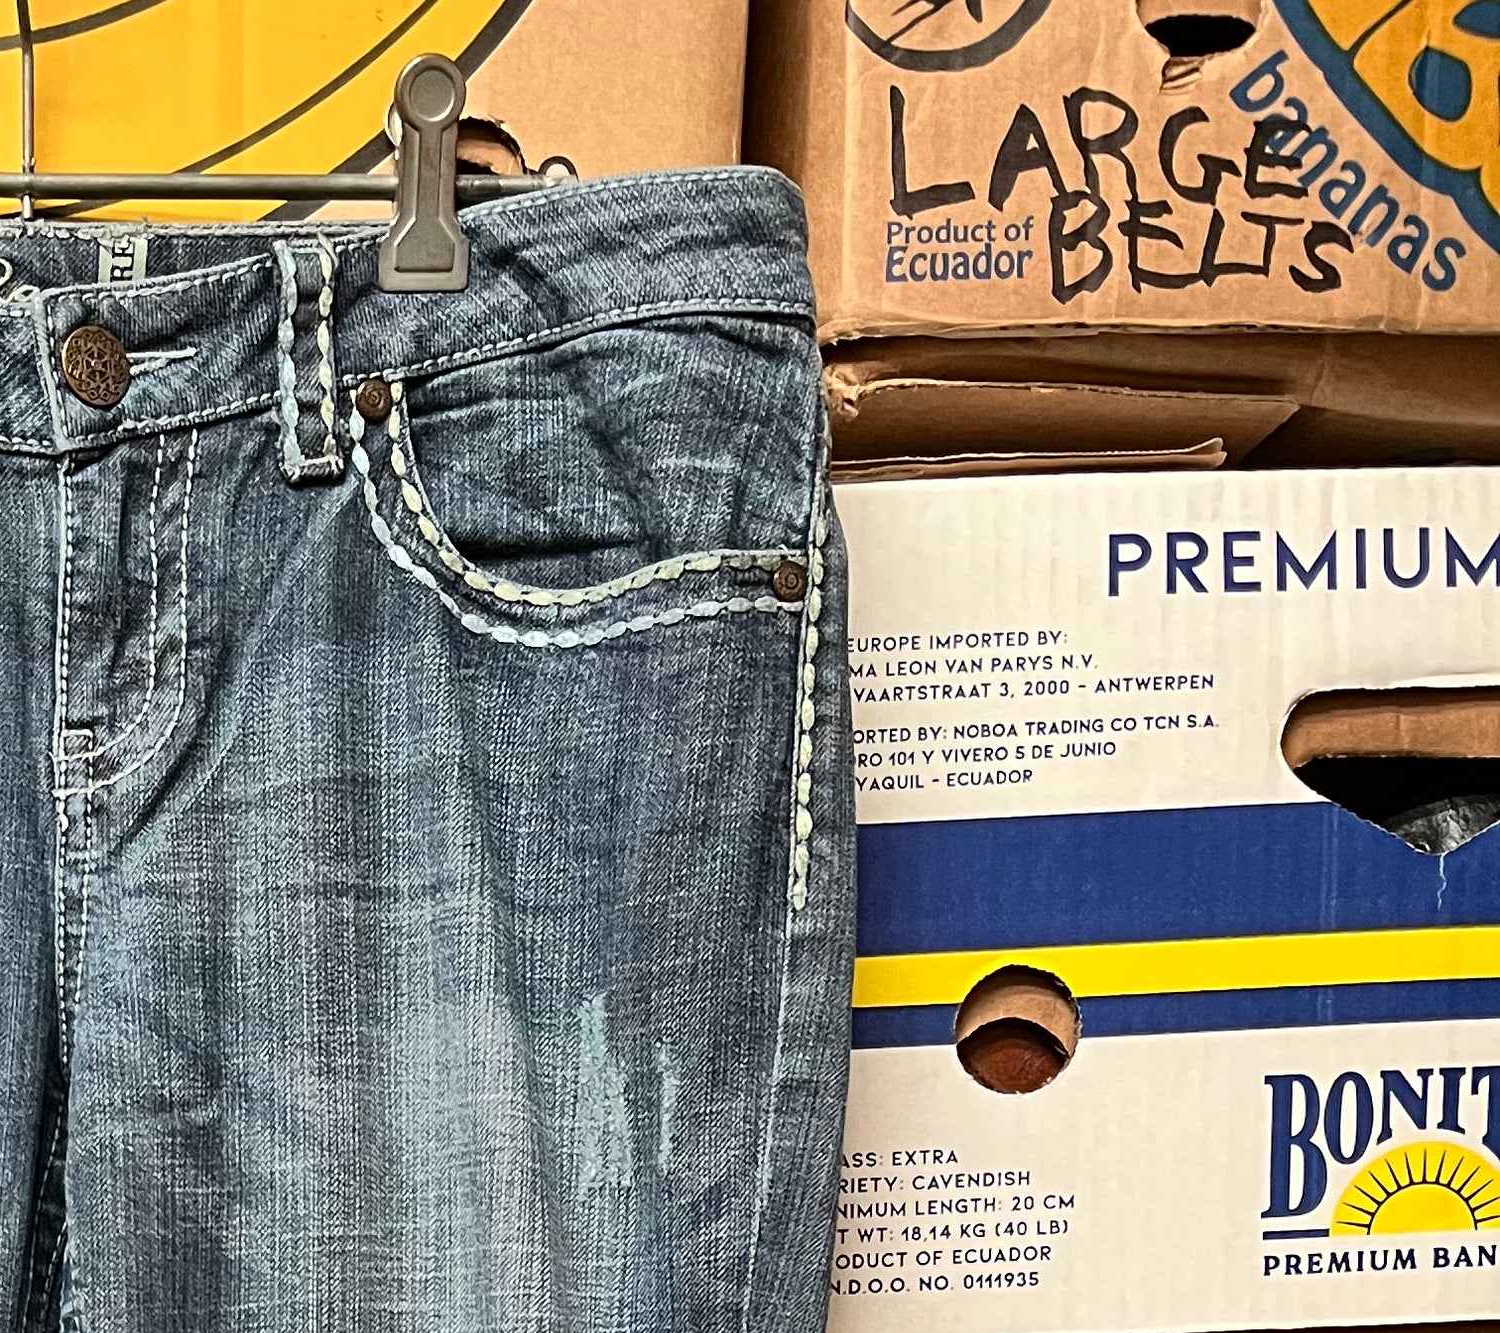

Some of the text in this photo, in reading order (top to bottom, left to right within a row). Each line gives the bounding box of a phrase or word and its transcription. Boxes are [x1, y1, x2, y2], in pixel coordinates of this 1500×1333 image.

[889, 85, 1311, 220] LARGE
[1229, 50, 1467, 291] bananas
[887, 215, 1034, 244] Product of
[1050, 190, 1353, 303] BELTS
[886, 243, 1033, 282] Ecuador
[930, 631, 1068, 650] IMPORTED BY:
[886, 654, 1098, 677] LEON VAN PARYS N.V.
[1024, 681, 1070, 696] 2000
[1095, 675, 1214, 694] ANTWERPEN
[918, 715, 1219, 741] BY: NOBOA TRADING CO TCN S.A.
[888, 742, 1116, 766] 101 VIVERO DE JUNIO
[947, 769, 1033, 788] ECUADOR
[892, 1150, 958, 1165] EXTRA
[913, 1171, 1030, 1190] CAVENDISH
[916, 1195, 1075, 1215] LENGTH: 20 CM
[858, 1220, 1068, 1243] WT: 18,14 KG (40 LB)
[916, 1246, 1051, 1266] OF ECUADOR
[1264, 1248, 1416, 1276] PREMIUM
[920, 1272, 1039, 1291] NO. 0111935
